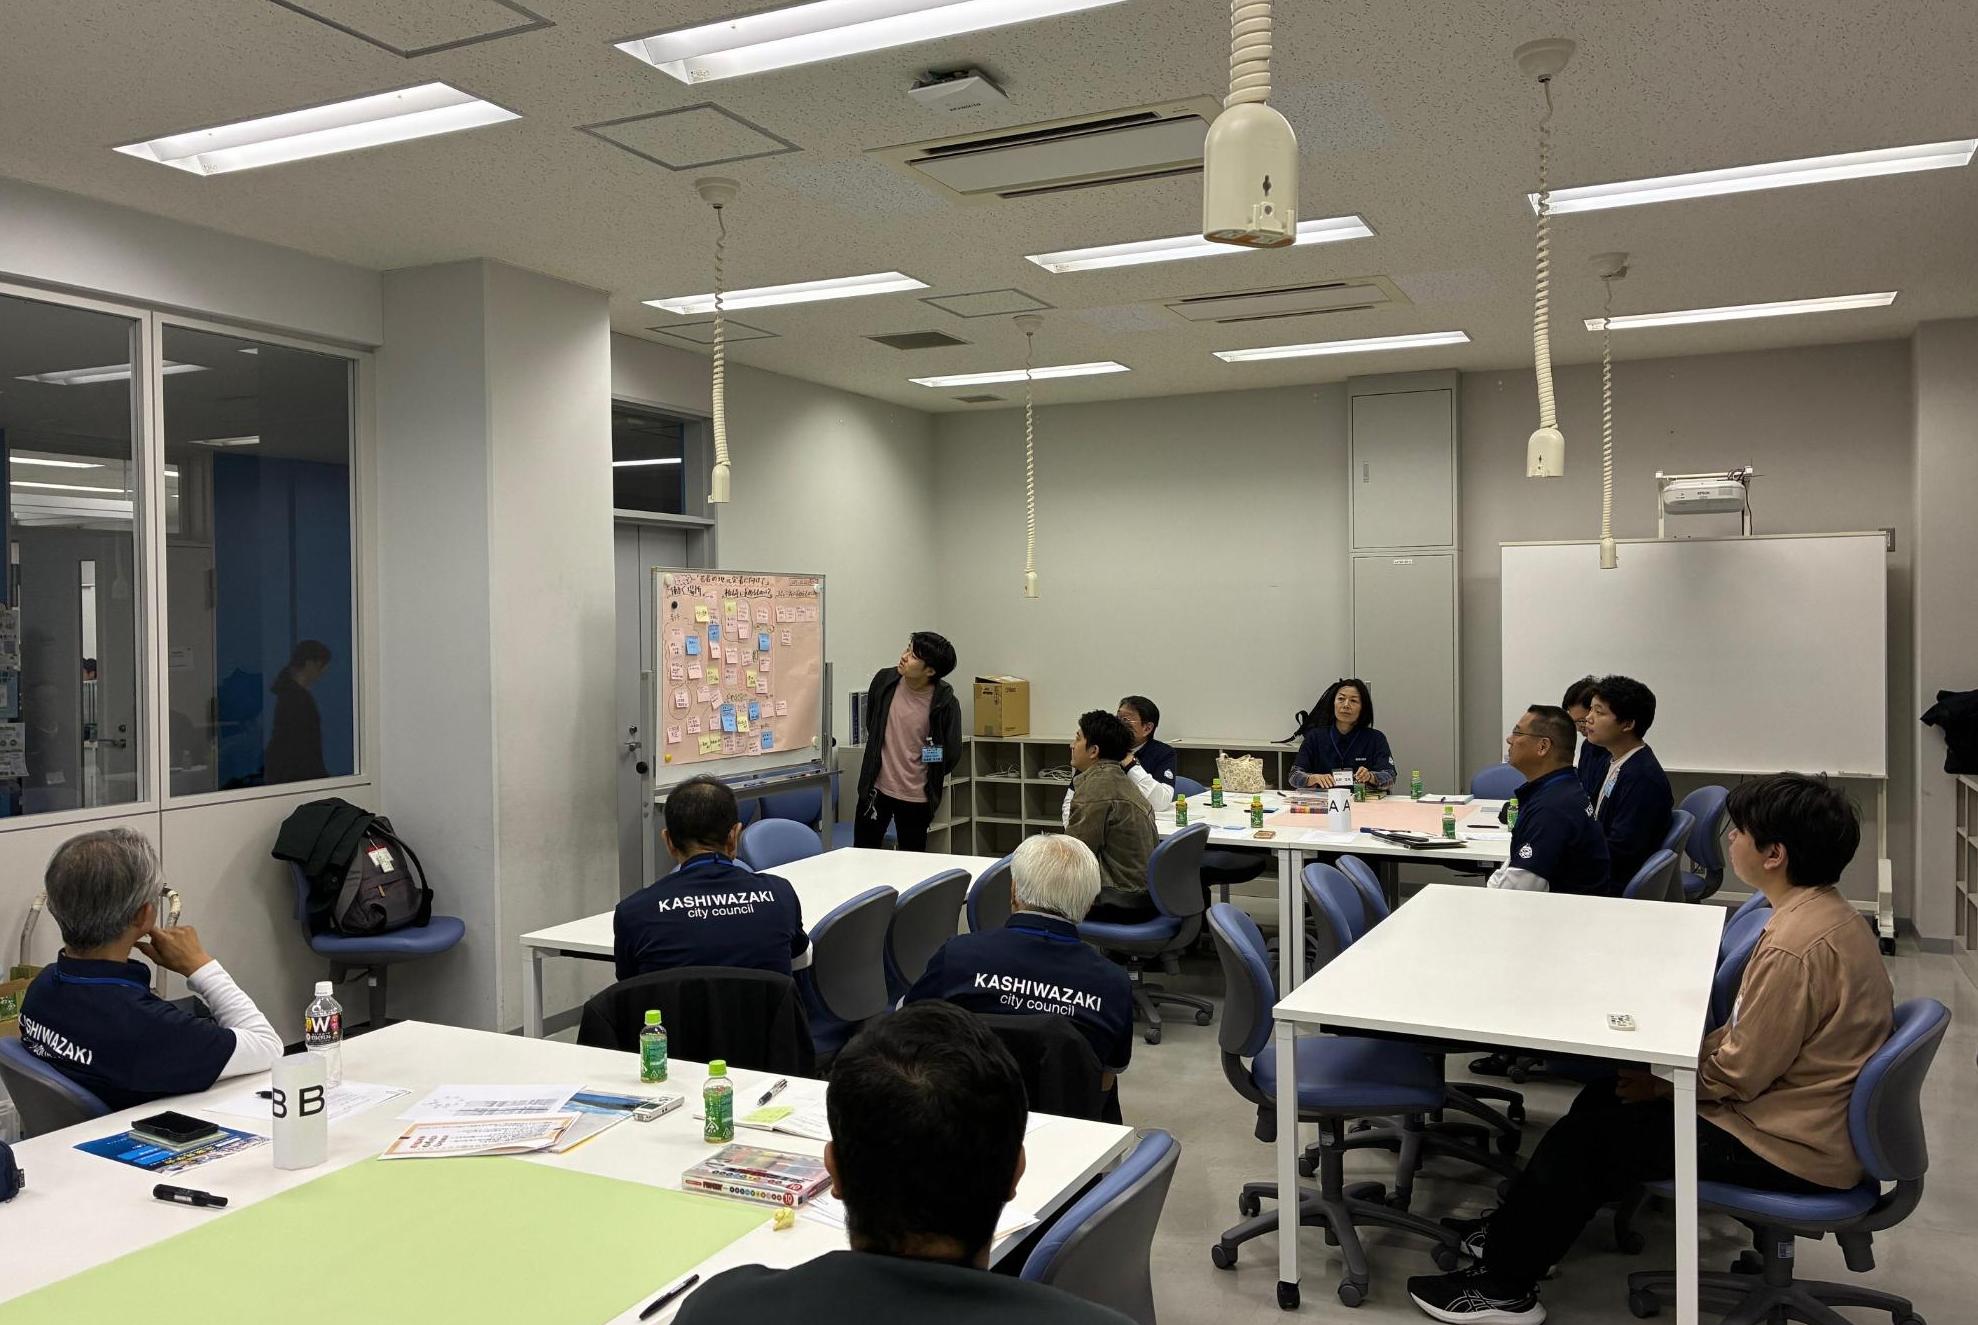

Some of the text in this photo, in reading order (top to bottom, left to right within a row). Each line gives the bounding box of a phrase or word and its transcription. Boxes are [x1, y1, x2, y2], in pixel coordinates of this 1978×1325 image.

[1329, 799, 1339, 812] A
[1343, 799, 1351, 811] A
[658, 890, 775, 913] KASHIWAZAKI
[687, 904, 754, 920] city council
[974, 972, 1102, 1012] KASHIWAZAKI
[999, 992, 1076, 1017] city council
[311, 1016, 331, 1033] W
[272, 1087, 288, 1119] B
[299, 1084, 325, 1118] B
